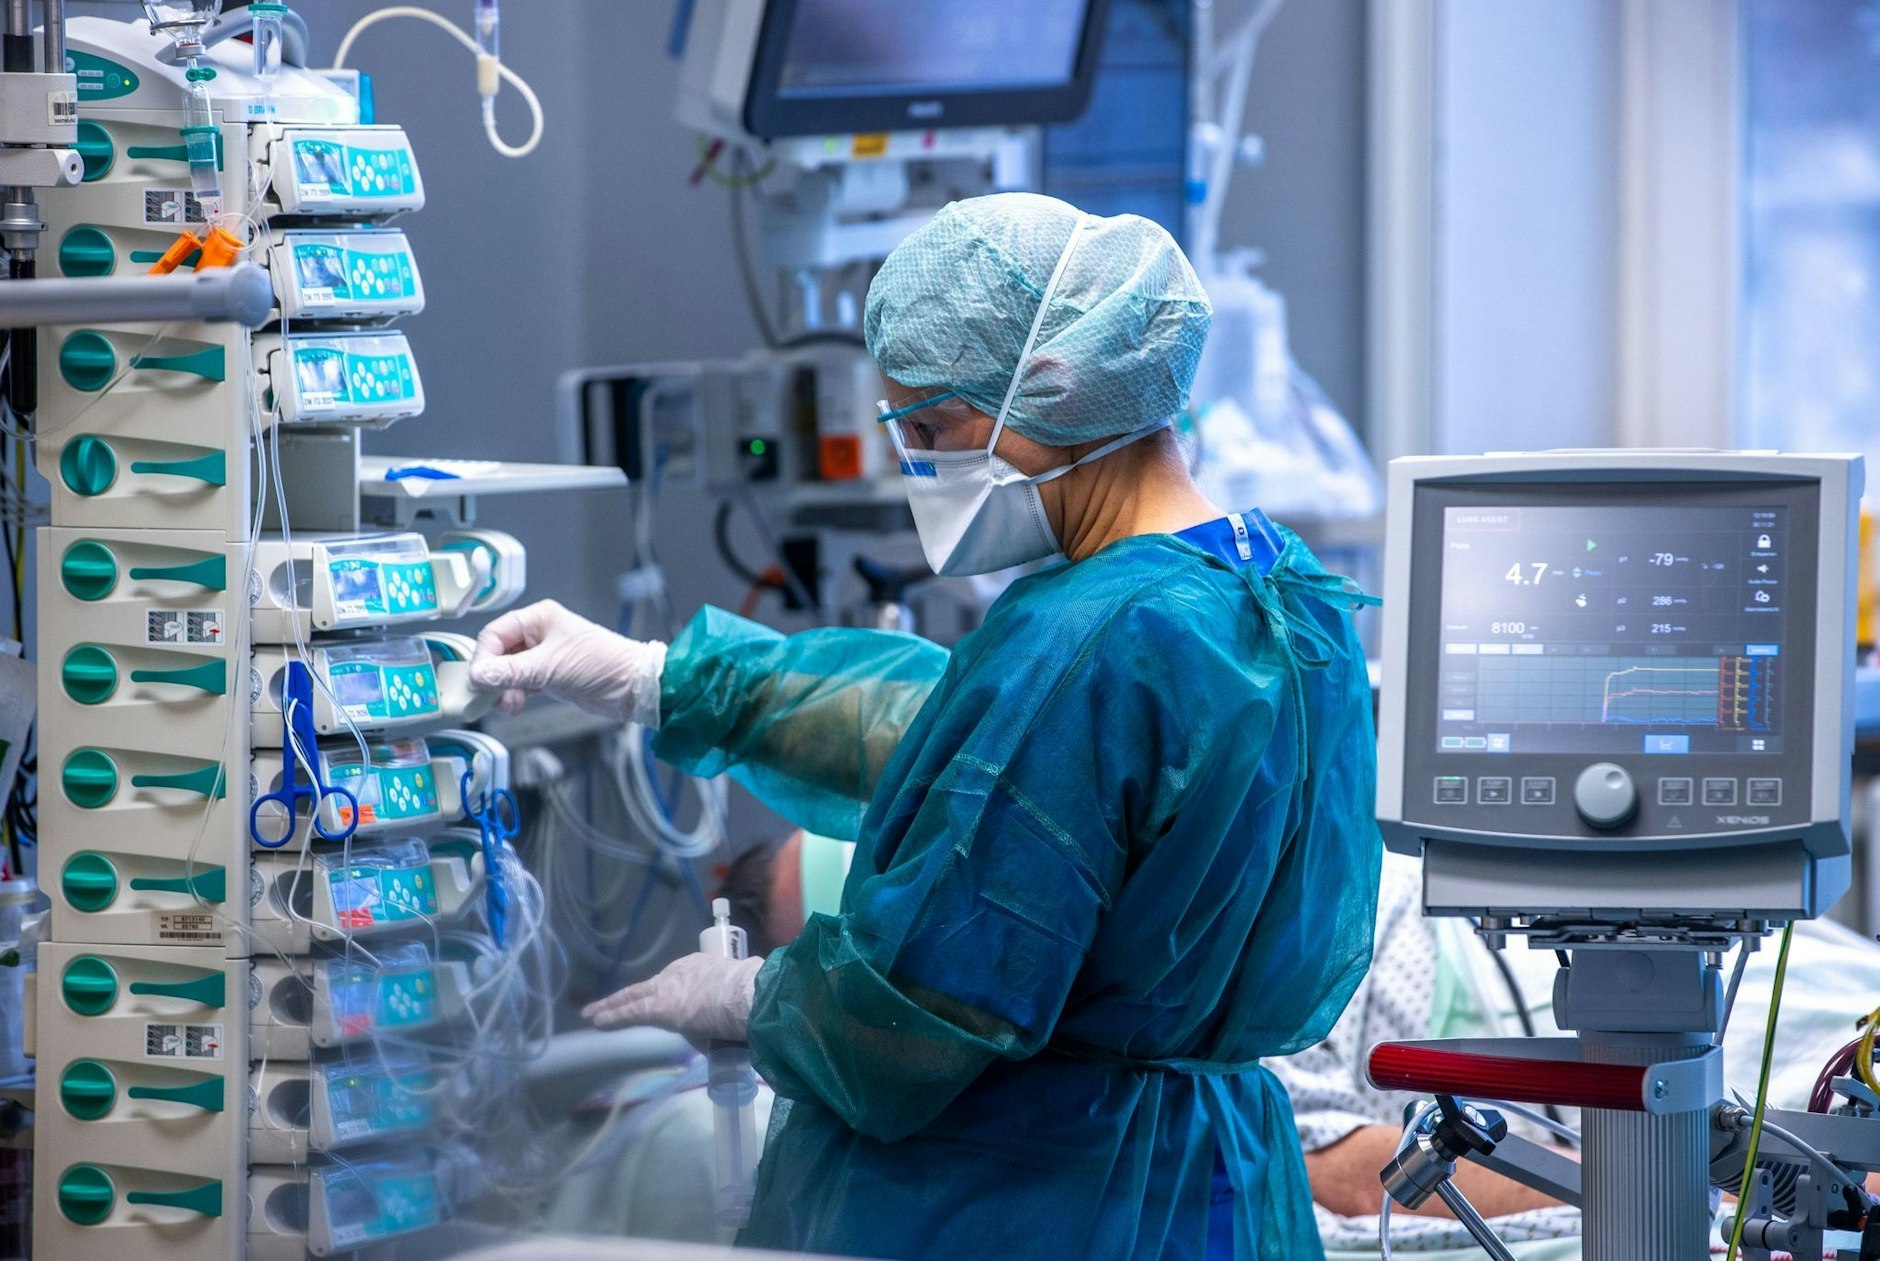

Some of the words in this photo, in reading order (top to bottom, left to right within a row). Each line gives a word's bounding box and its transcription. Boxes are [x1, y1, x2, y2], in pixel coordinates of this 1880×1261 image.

[1649, 553, 1674, 566] -79
[1504, 562, 1548, 586] 4.7
[1652, 596, 1673, 606] 286
[1491, 622, 1525, 634] 8100
[1651, 623, 1672, 634] 215
